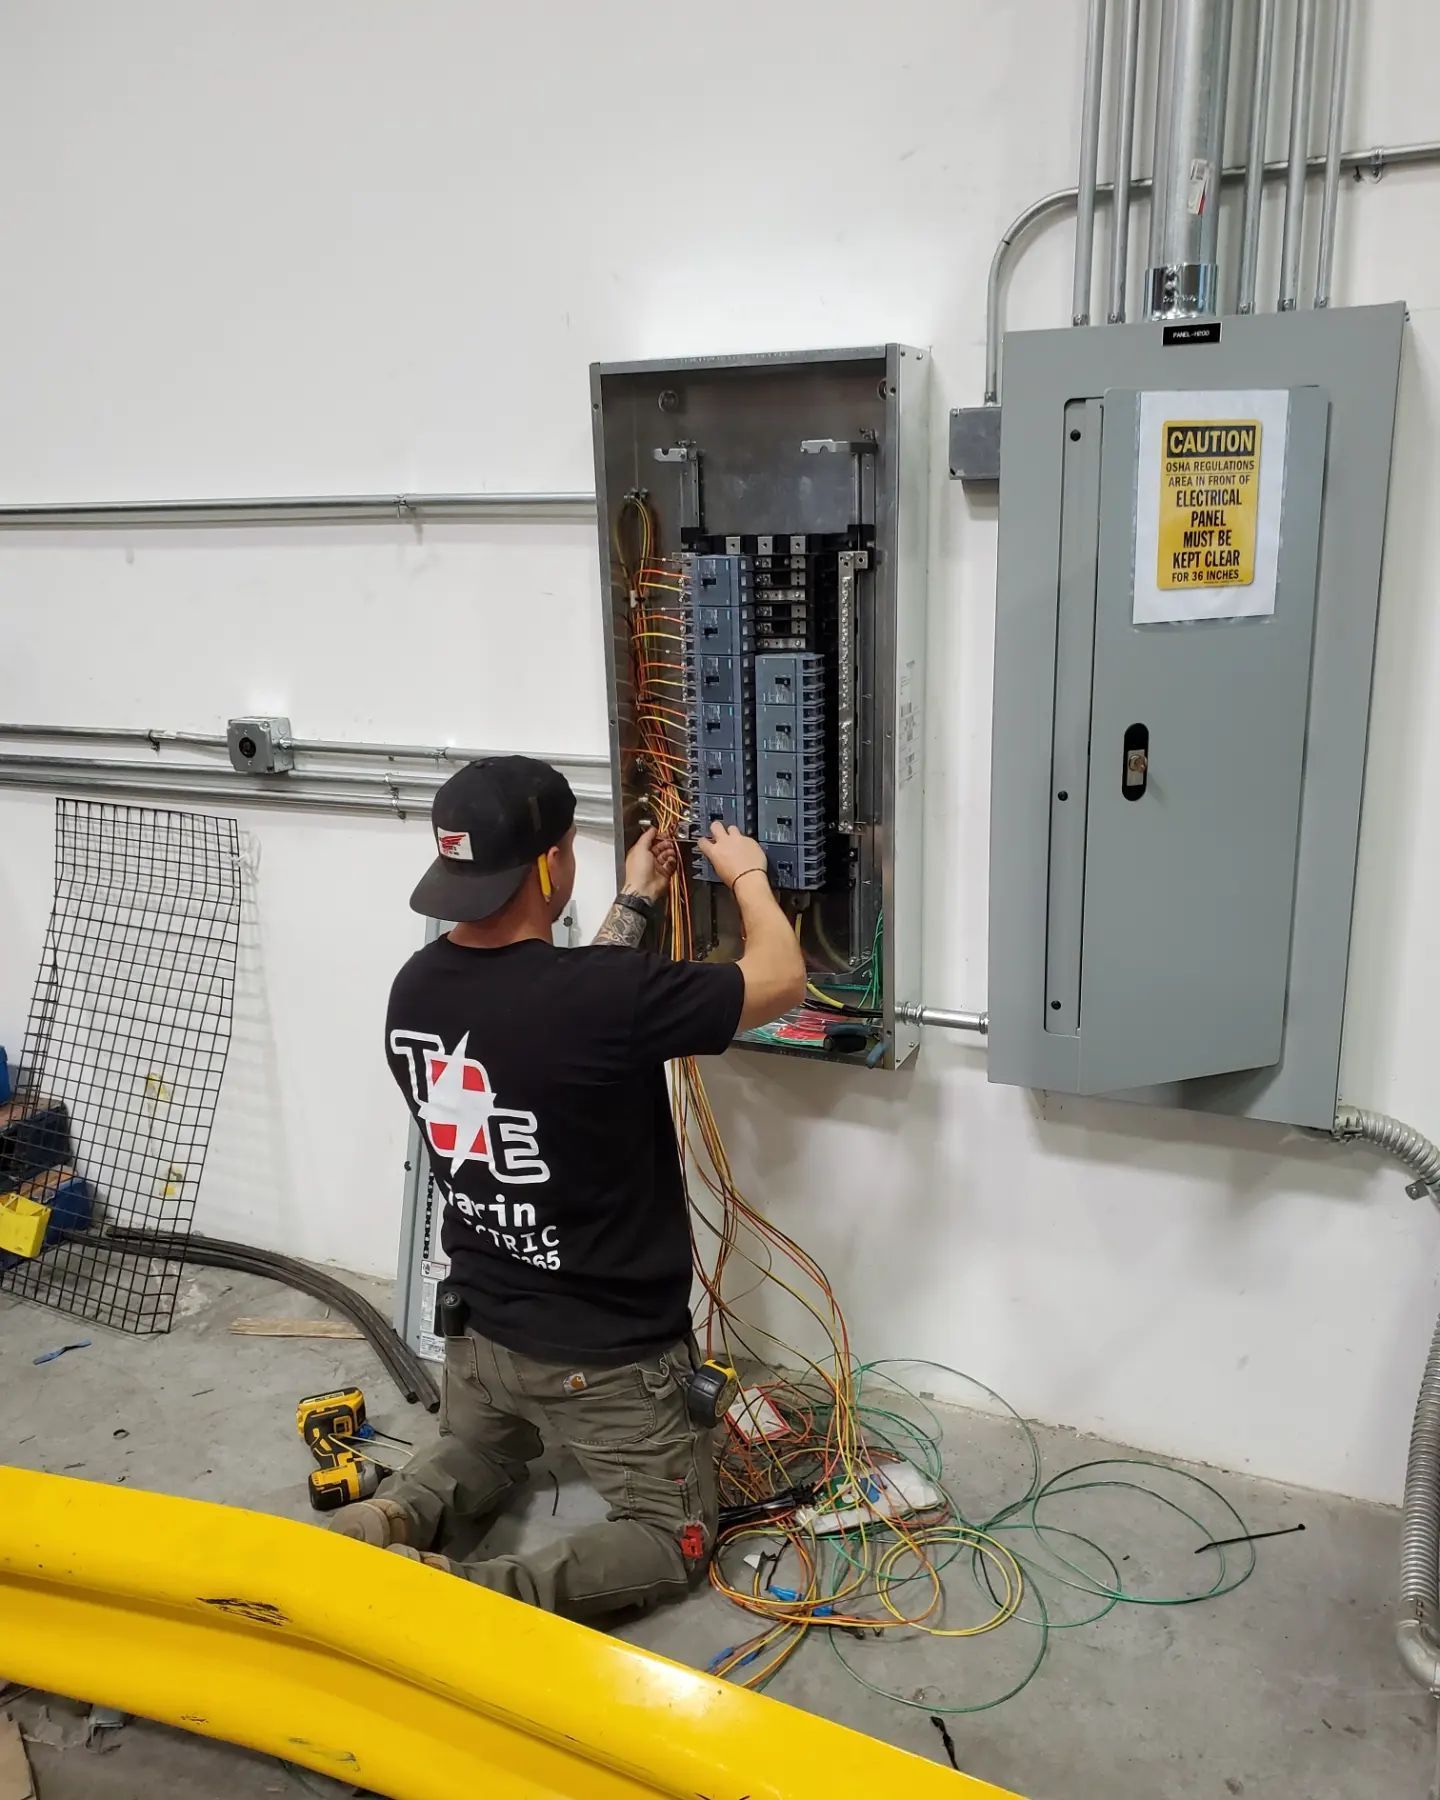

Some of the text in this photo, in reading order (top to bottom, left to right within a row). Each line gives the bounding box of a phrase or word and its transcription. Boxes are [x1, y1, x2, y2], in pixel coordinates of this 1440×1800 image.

[1169, 430, 1253, 453] CAUTION
[1166, 460, 1255, 473] OSHA REGULATIONS
[1168, 474, 1251, 487] AREA IN FRONT OF
[1176, 488, 1242, 508] ELECTRICAL
[1190, 509, 1227, 528] PANEL
[1183, 529, 1233, 549] MUST BE
[1172, 549, 1241, 569] KEPT CLEAR
[1172, 572, 1189, 583] FOR
[1191, 571, 1204, 582] 36
[1206, 569, 1240, 580] INCHES
